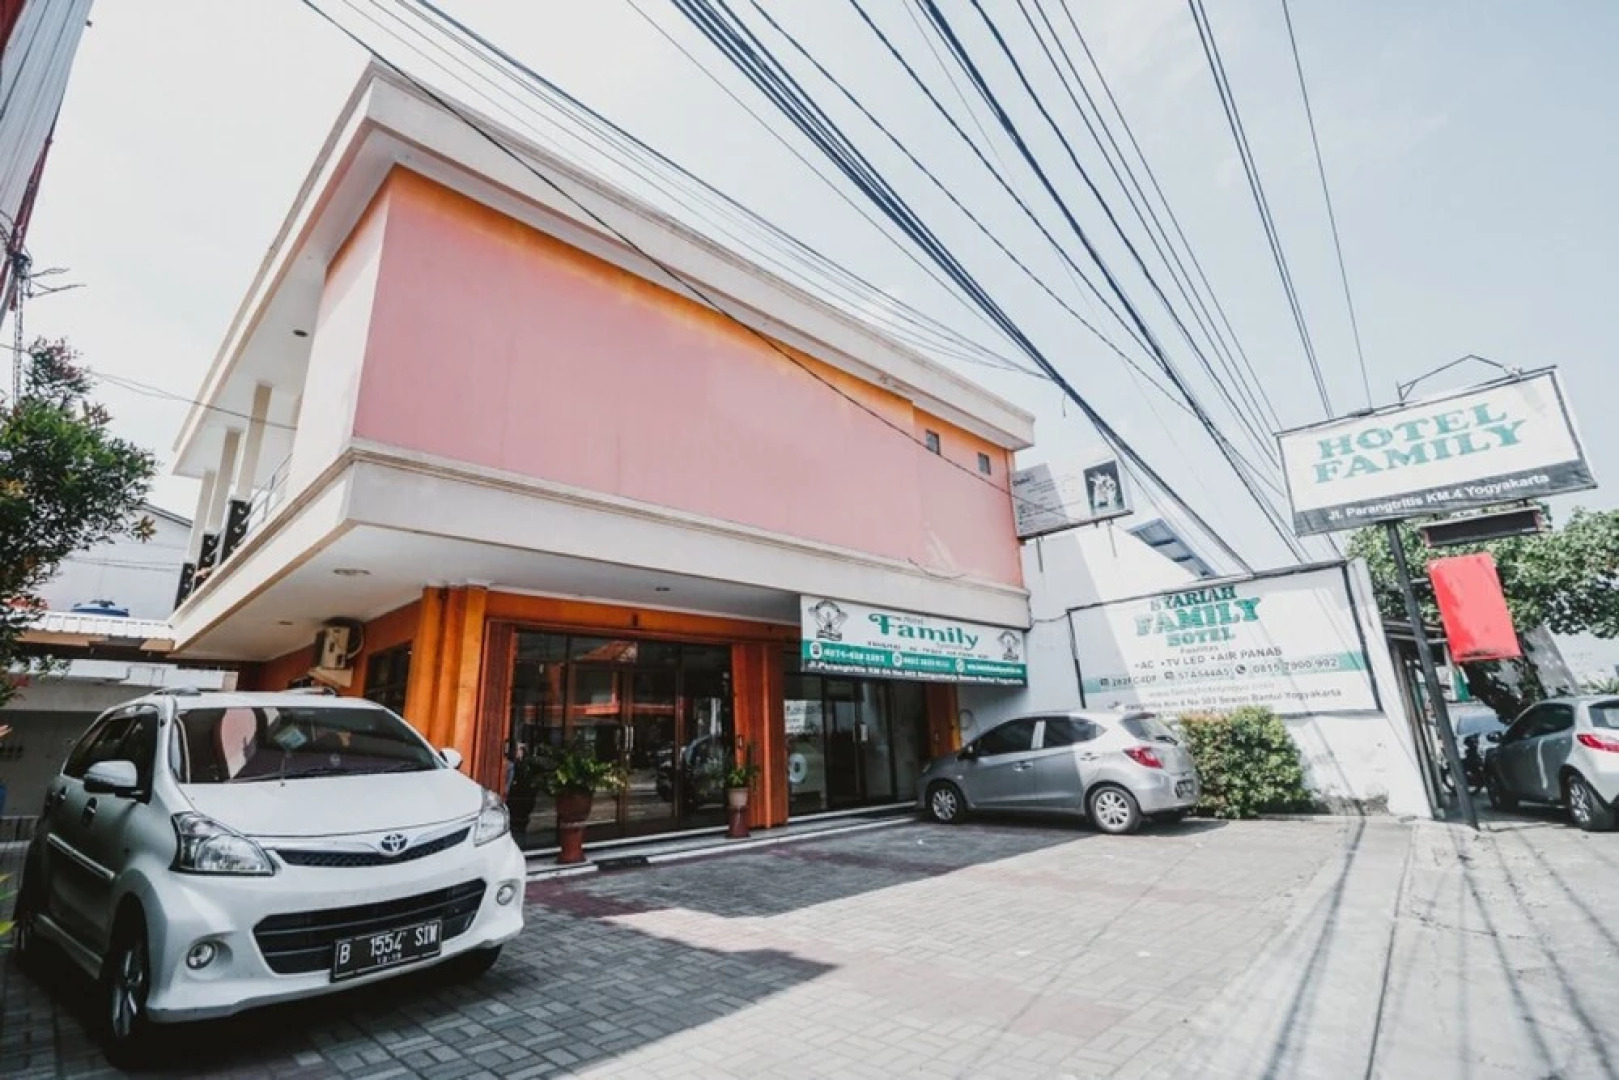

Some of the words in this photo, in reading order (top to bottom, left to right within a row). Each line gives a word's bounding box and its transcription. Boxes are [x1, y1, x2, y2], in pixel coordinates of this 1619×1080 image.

[1316, 402, 1508, 459] HOTEL
[1311, 419, 1526, 484] FAMILY
[1464, 473, 1550, 501] Yogyakarta
[867, 612, 979, 651] Family
[1133, 596, 1262, 637] FAMILY
[1166, 657, 1181, 668] TV
[1183, 655, 1206, 665] LED
[1216, 650, 1238, 661] AIR
[339, 943, 351, 965] B
[370, 931, 407, 958] 1554
